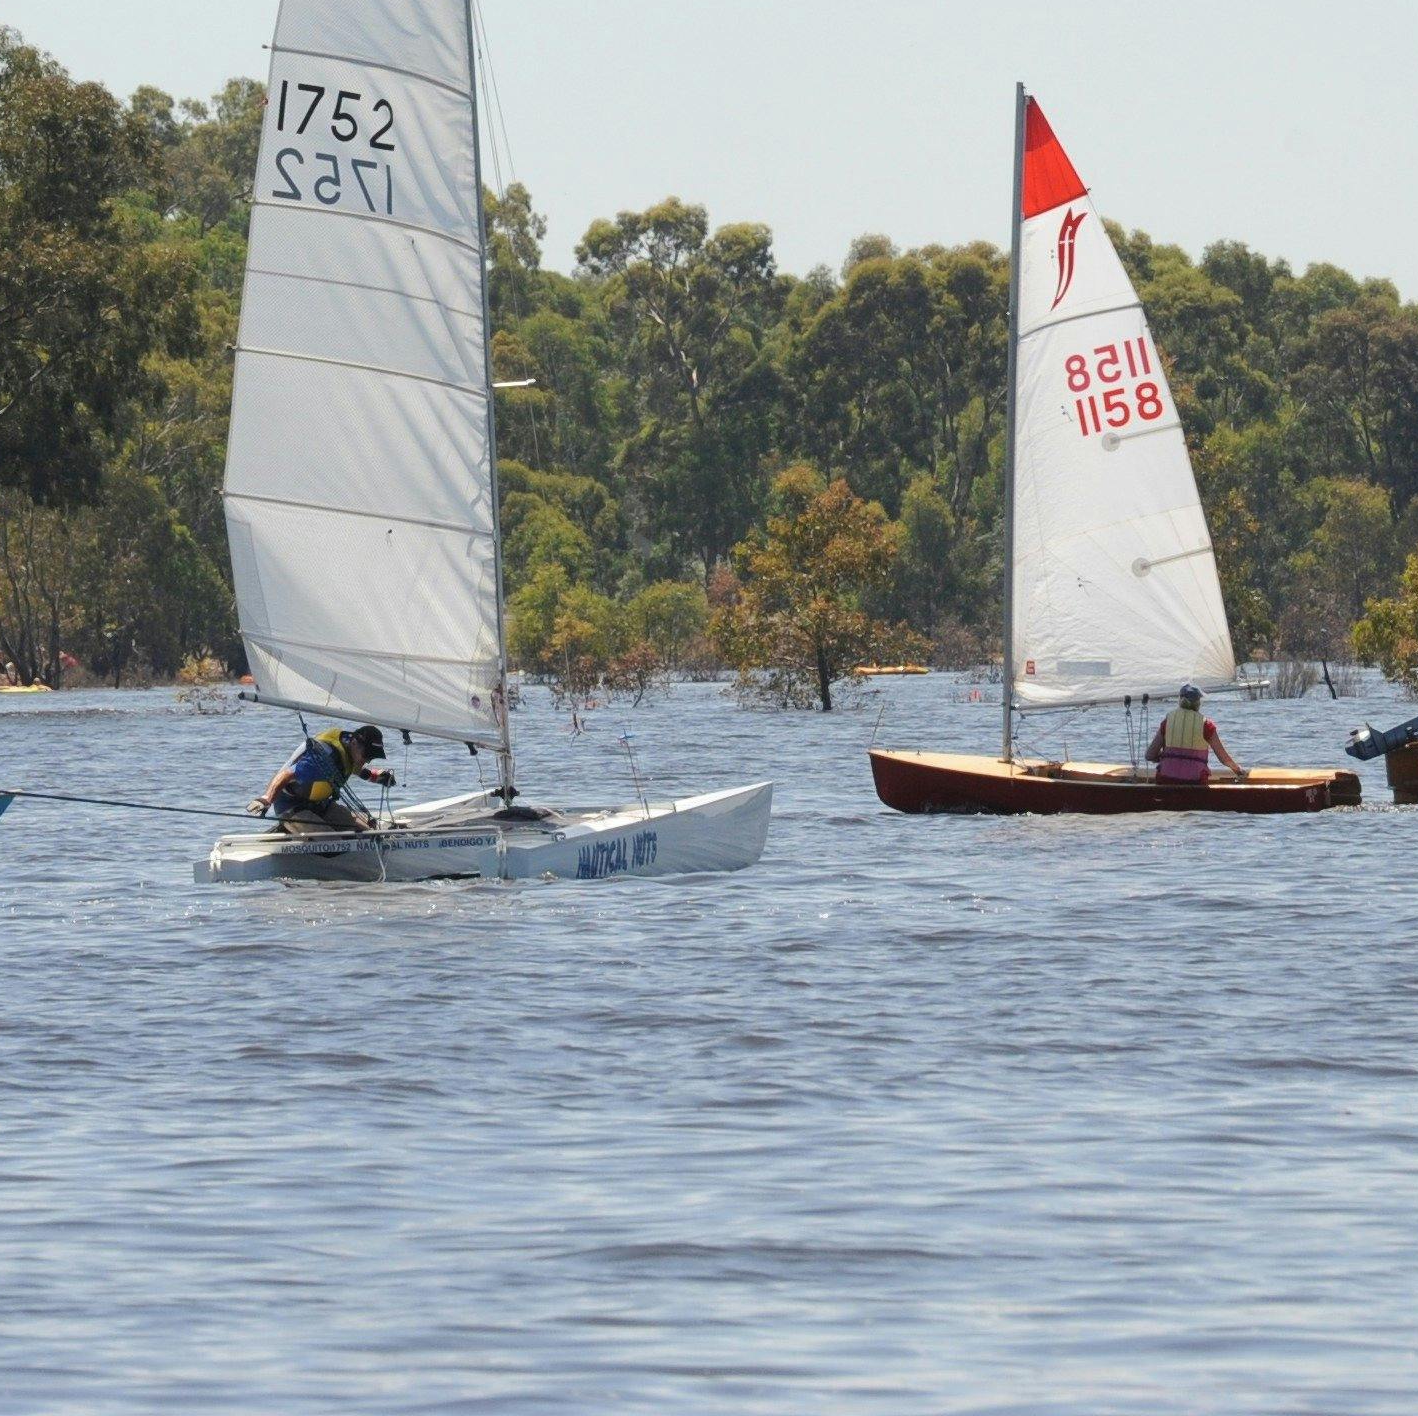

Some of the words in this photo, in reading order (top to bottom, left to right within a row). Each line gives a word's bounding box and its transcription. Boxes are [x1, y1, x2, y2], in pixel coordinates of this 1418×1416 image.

[278, 80, 395, 151] 1752
[1076, 382, 1163, 436] 1158
[281, 843, 329, 854] MOSQUITO
[356, 840, 402, 852] NAUAL
[404, 839, 430, 849] NUTS
[439, 836, 484, 848] BENDIGO
[576, 836, 628, 879] NAUTICAL
[631, 829, 658, 868] NUTS
